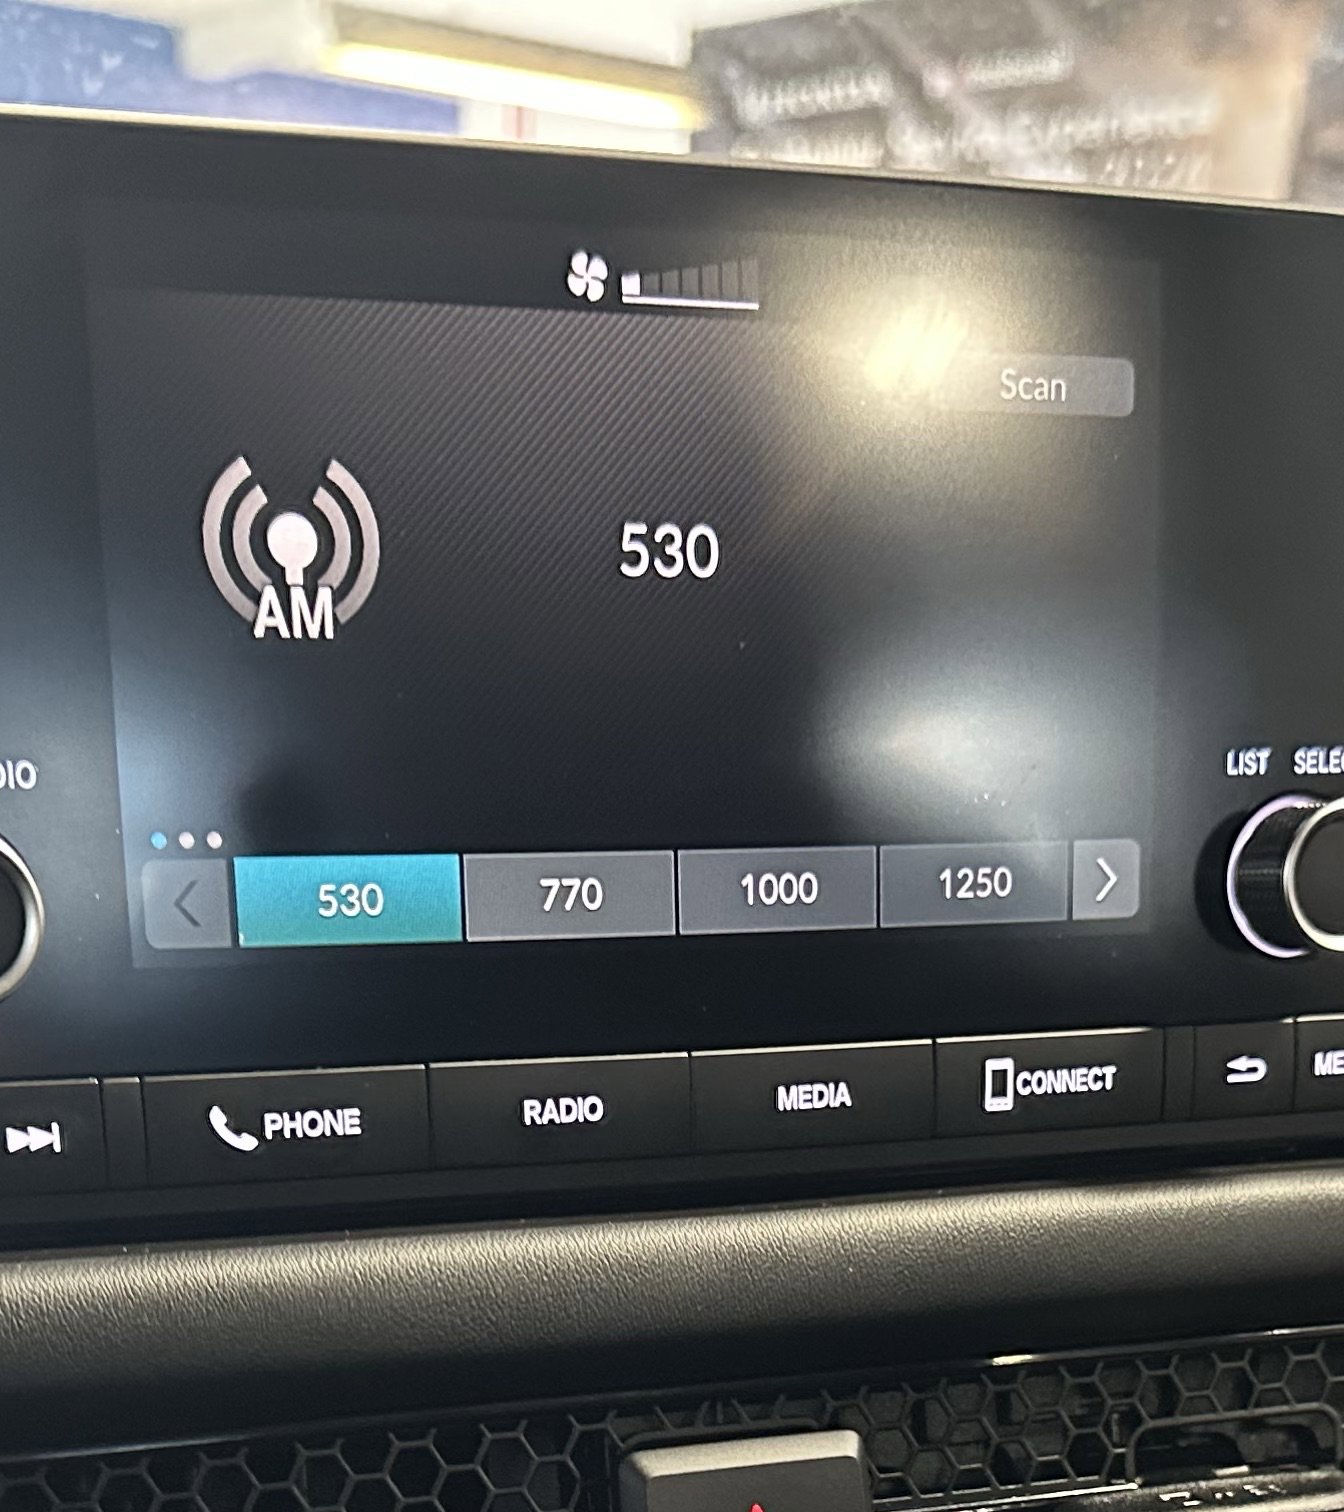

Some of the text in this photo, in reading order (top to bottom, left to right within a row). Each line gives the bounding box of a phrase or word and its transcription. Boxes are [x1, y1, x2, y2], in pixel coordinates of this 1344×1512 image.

[999, 368, 1067, 402] Scan
[620, 522, 720, 578] 530
[254, 585, 334, 640] AM
[1226, 747, 1272, 776] LIST
[539, 877, 604, 913] 770
[740, 872, 818, 906] 1000
[938, 866, 1013, 899] 1250
[317, 883, 384, 917] 530
[777, 1082, 852, 1112] MEDIA
[1016, 1065, 1117, 1096] CONNECT
[263, 1107, 362, 1140] PHONE
[523, 1096, 604, 1126] RADIO
